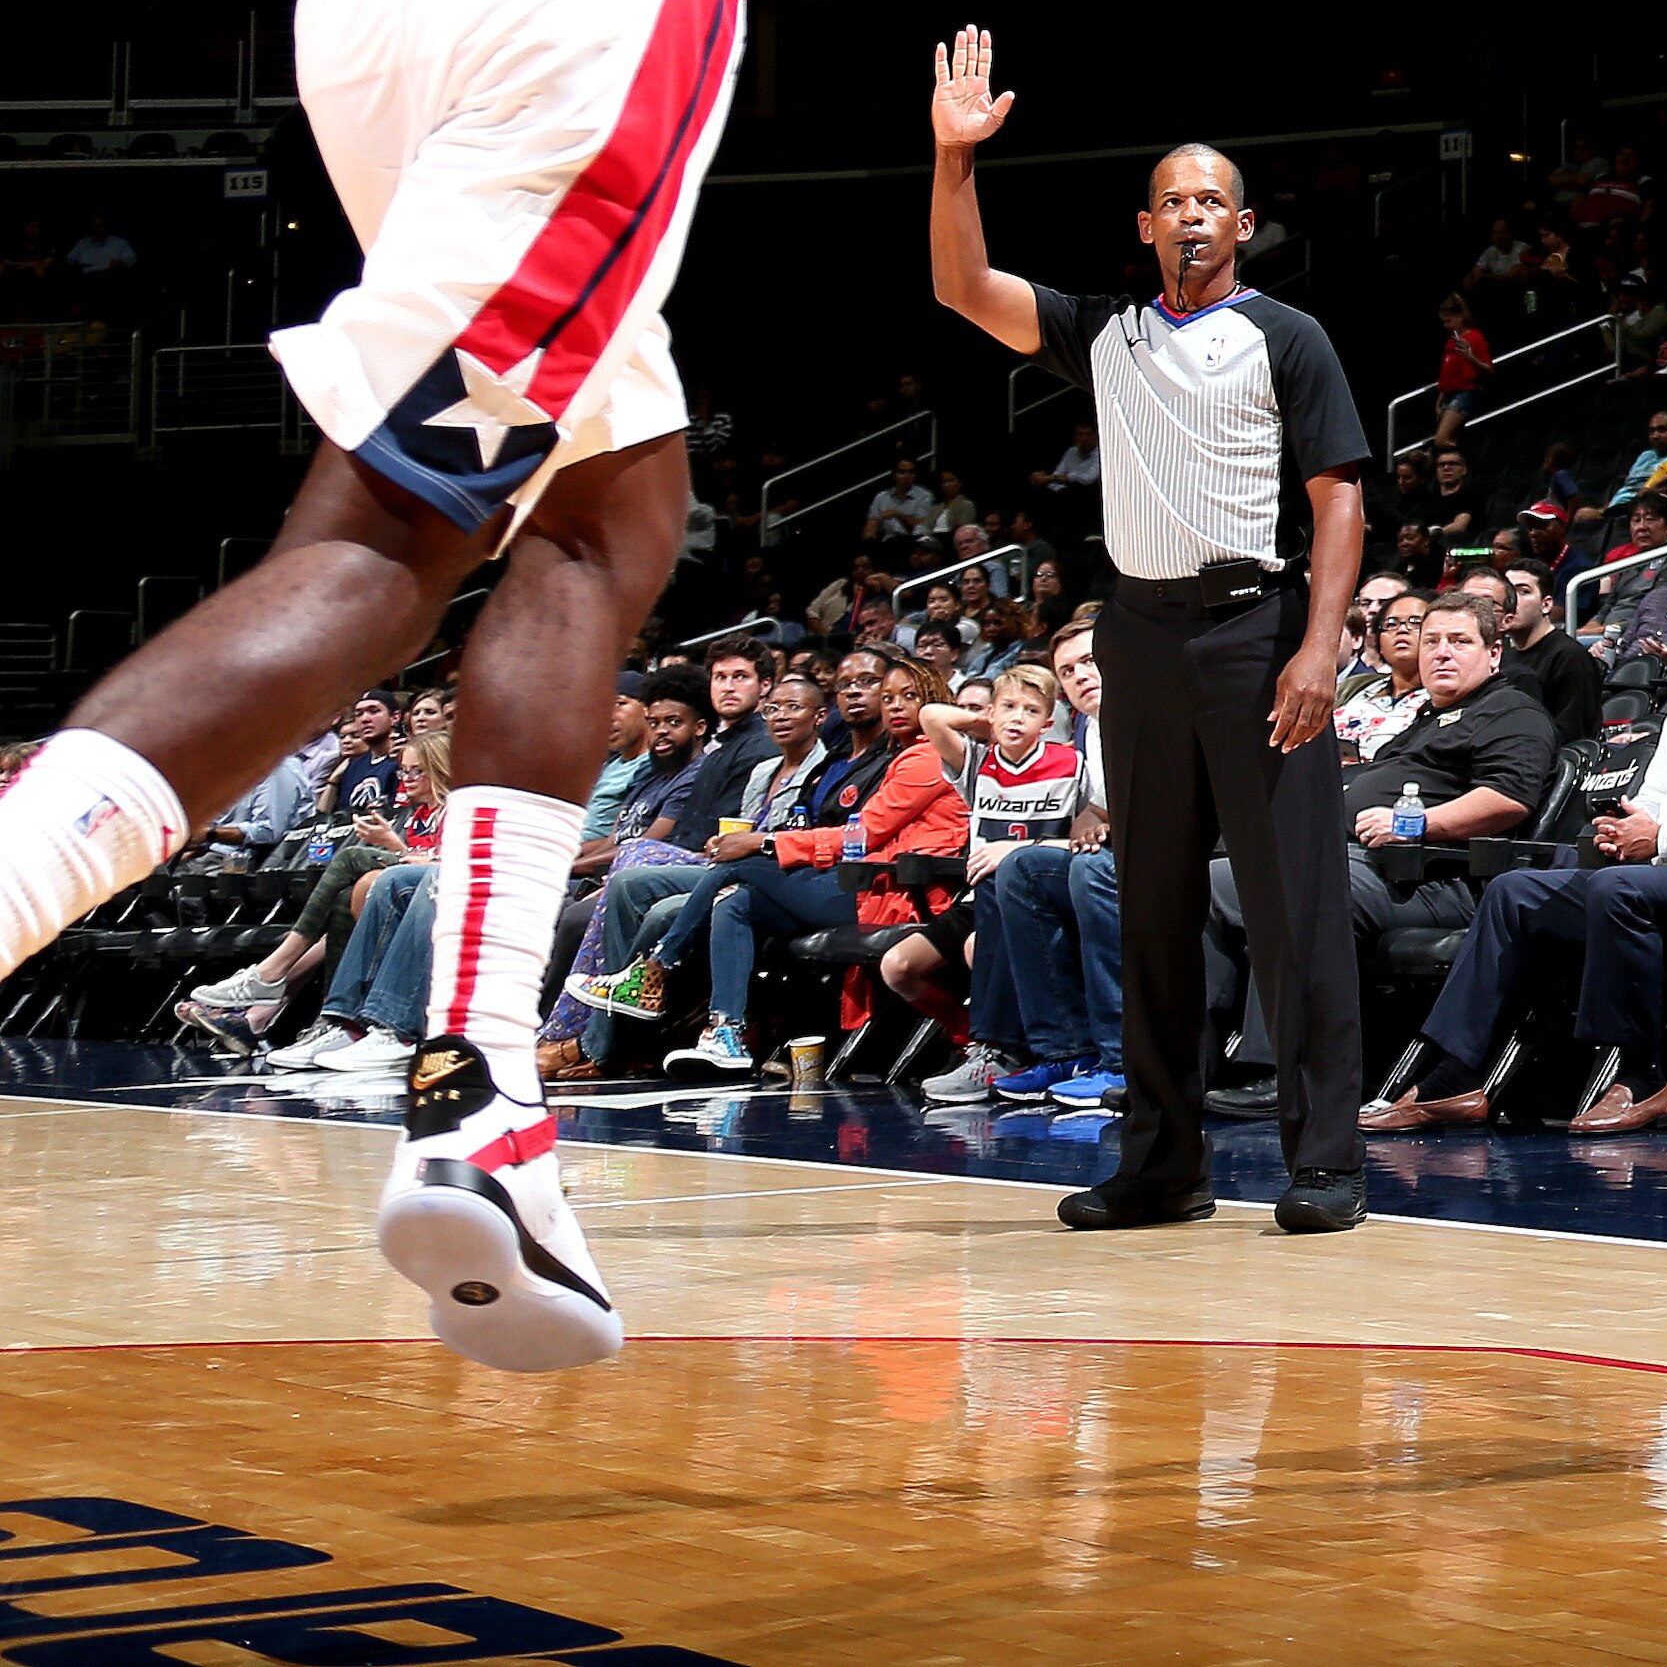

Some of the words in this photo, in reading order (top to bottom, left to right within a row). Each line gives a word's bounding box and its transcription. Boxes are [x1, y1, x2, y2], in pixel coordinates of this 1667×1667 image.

[229, 176, 263, 191] 115
[1581, 760, 1639, 792] wizards
[978, 793, 1061, 812] wizards
